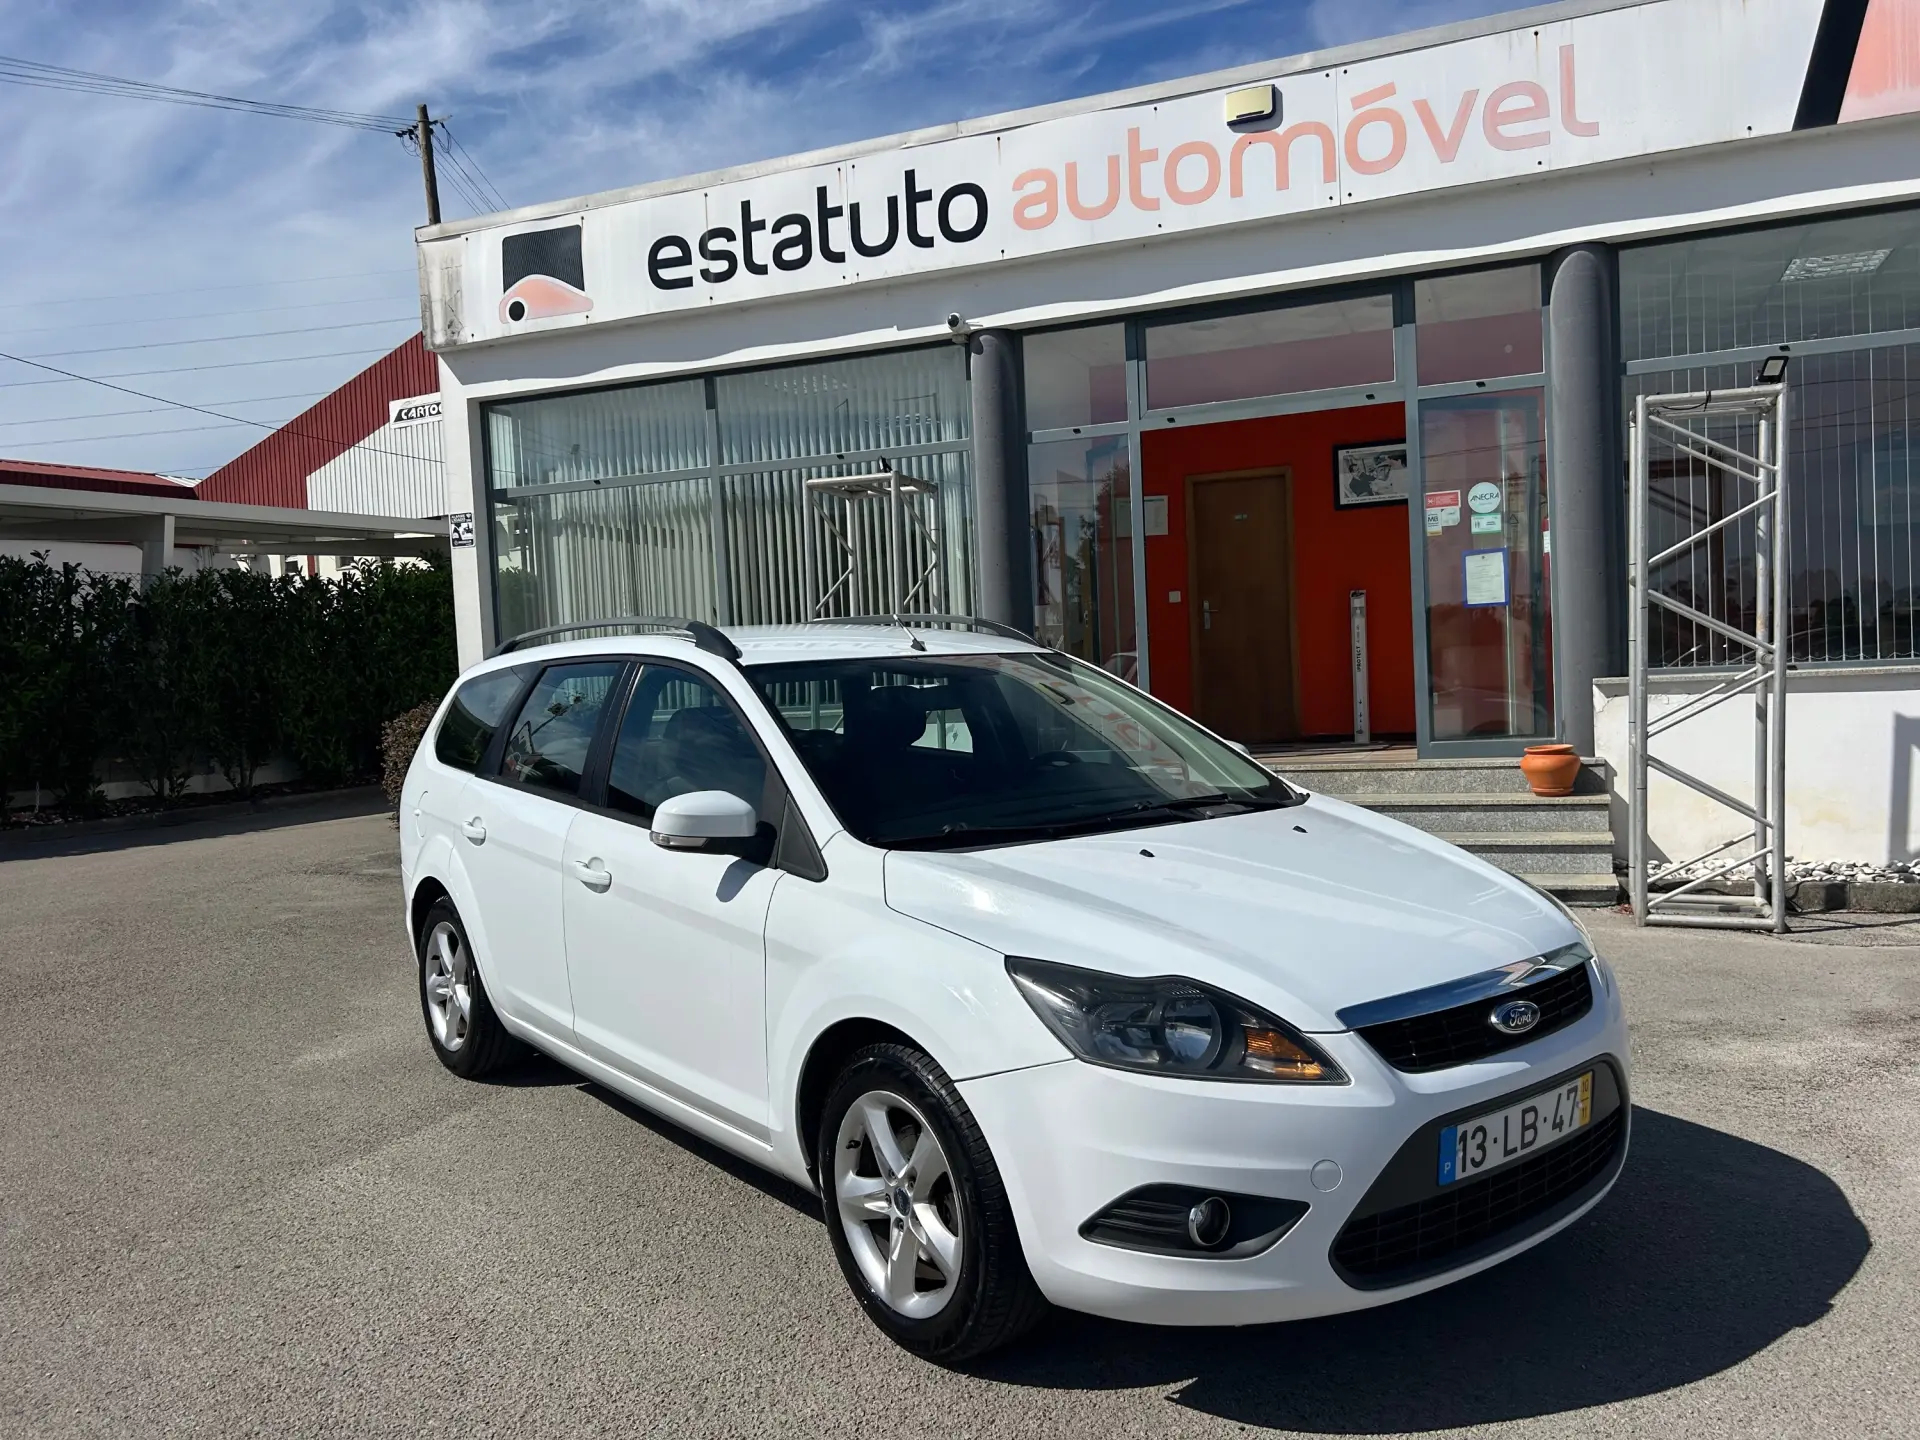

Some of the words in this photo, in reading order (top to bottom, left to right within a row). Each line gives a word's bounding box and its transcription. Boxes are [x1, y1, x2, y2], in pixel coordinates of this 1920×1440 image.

[647, 169, 989, 291] estatuto
[1011, 43, 1600, 230] automóvel
[1470, 491, 1500, 502] ANECRA
[1509, 1007, 1532, 1027] Ford
[1582, 1079, 1589, 1093] 10
[1443, 1161, 1451, 1174] P
